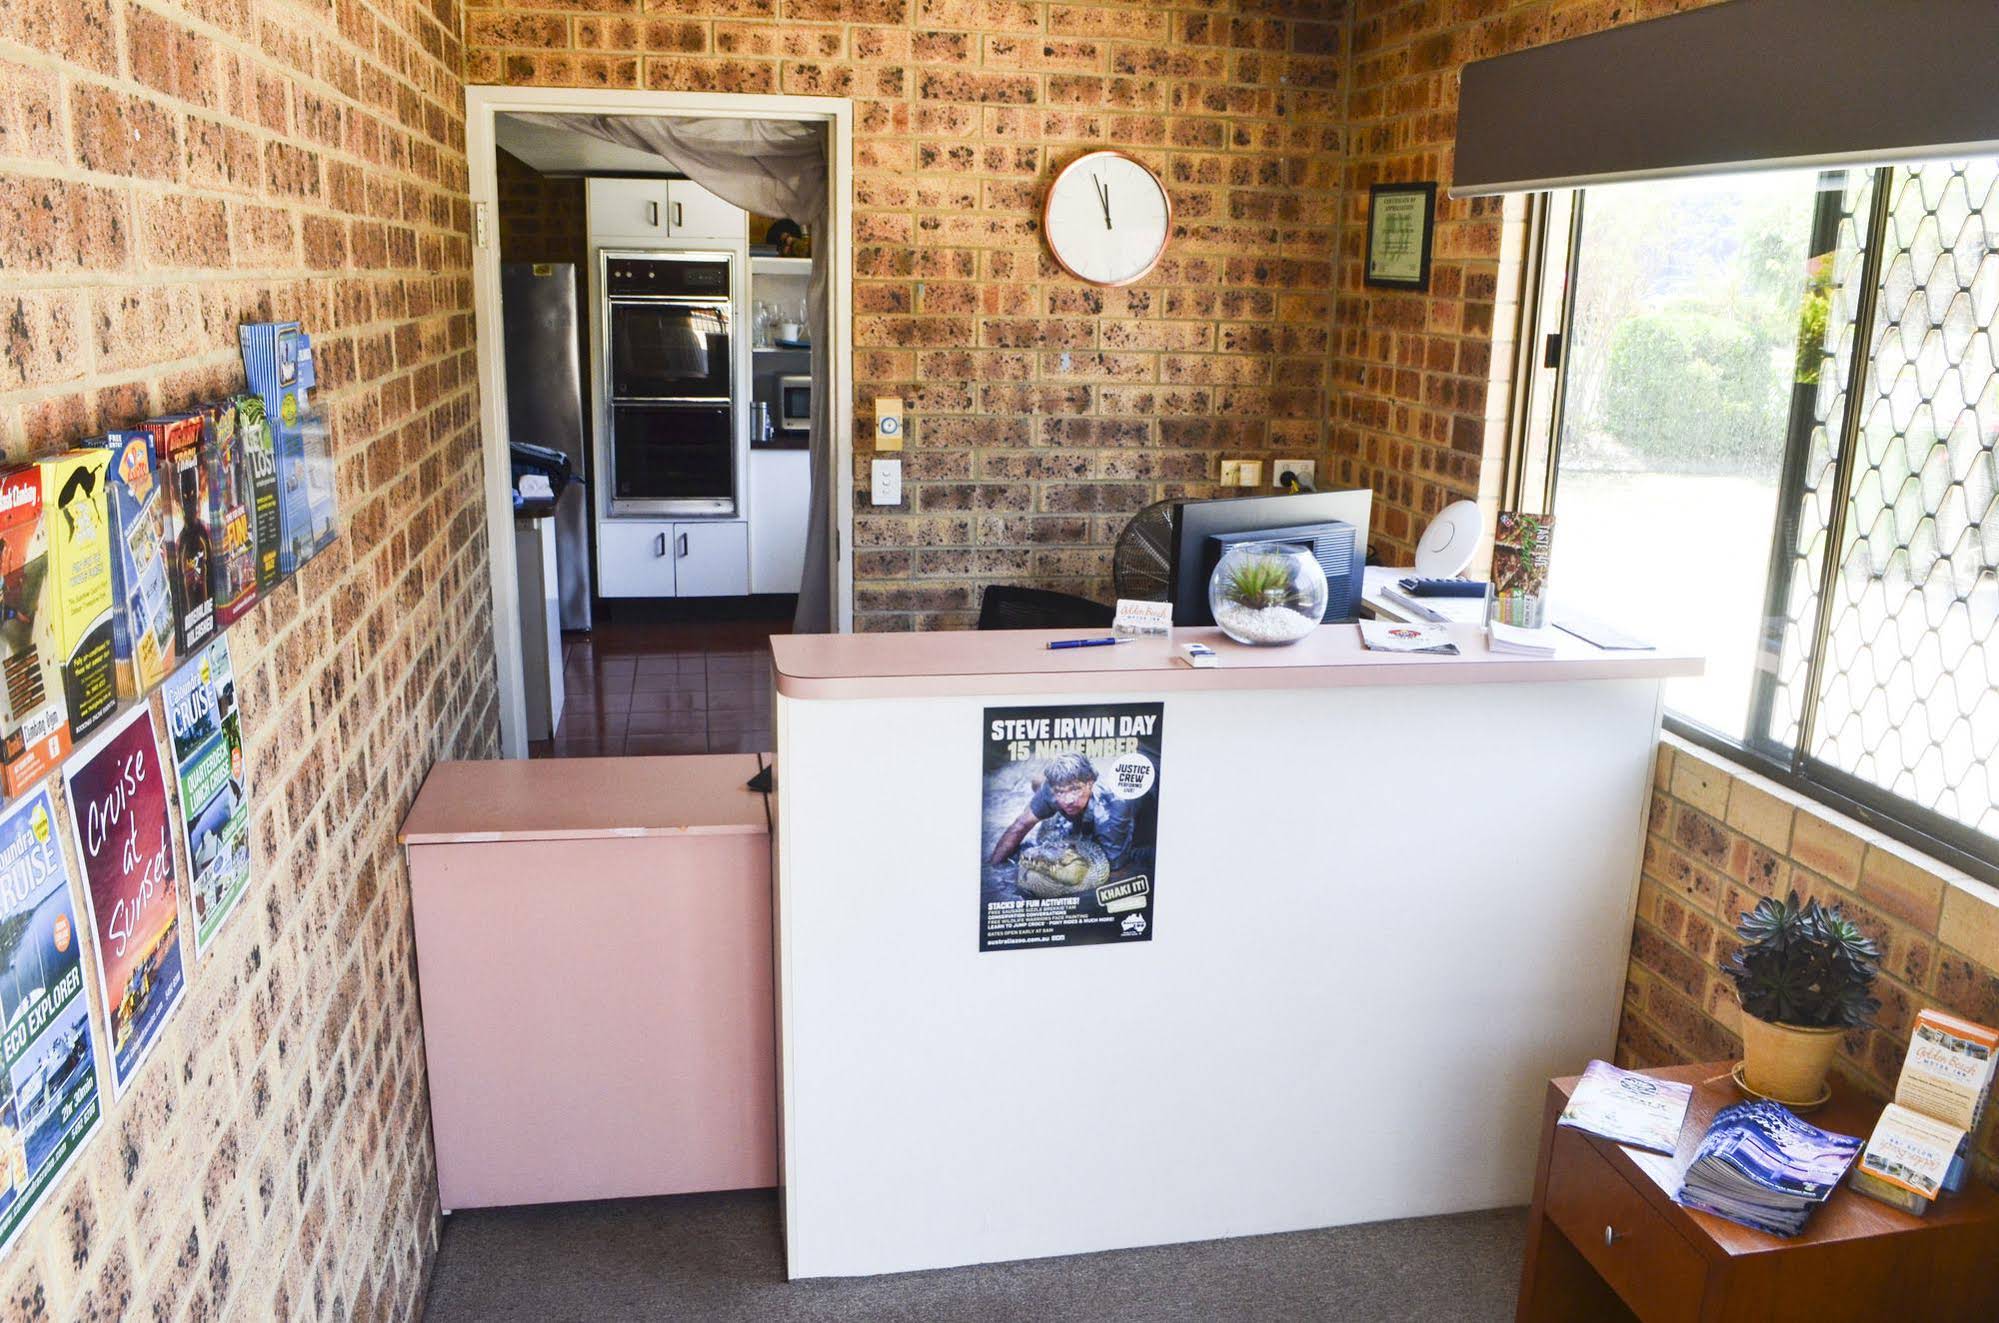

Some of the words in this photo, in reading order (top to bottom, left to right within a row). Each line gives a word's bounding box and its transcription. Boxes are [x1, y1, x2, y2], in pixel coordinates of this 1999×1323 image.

[252, 448, 276, 478] LOST
[172, 682, 215, 737] CRUISE
[991, 718, 1050, 741] STEVE
[1054, 716, 1114, 739] IRWIN
[1119, 715, 1157, 737] DAY
[187, 740, 229, 792] QUARTERDECK
[1007, 740, 1030, 761] 15
[1035, 737, 1139, 761] NOVEMBER
[189, 780, 210, 815] LUNCH
[210, 758, 230, 792] CRUISE
[1115, 763, 1151, 775] JUSTICE
[1119, 773, 1144, 783] CREW
[87, 749, 146, 857] Cruise
[0, 827, 35, 870] oundra
[122, 810, 143, 876] at
[0, 840, 58, 916] RUISE
[109, 825, 171, 958] Sunset
[1100, 883, 1132, 902] KHAKI
[1131, 879, 1146, 893] IT!
[987, 900, 1016, 910] STACKS
[1015, 900, 1025, 909] OF
[1026, 899, 1040, 908] FUN
[1026, 910, 1067, 918] CONVERSATIONS
[987, 936, 1050, 946] australiazoo.com.au
[3, 1025, 28, 1066] ECO
[28, 965, 80, 1037] EXPLORER
[1947, 1055, 1978, 1077] Beach
[61, 1104, 73, 1124] 2hr
[73, 1076, 95, 1108] 30min
